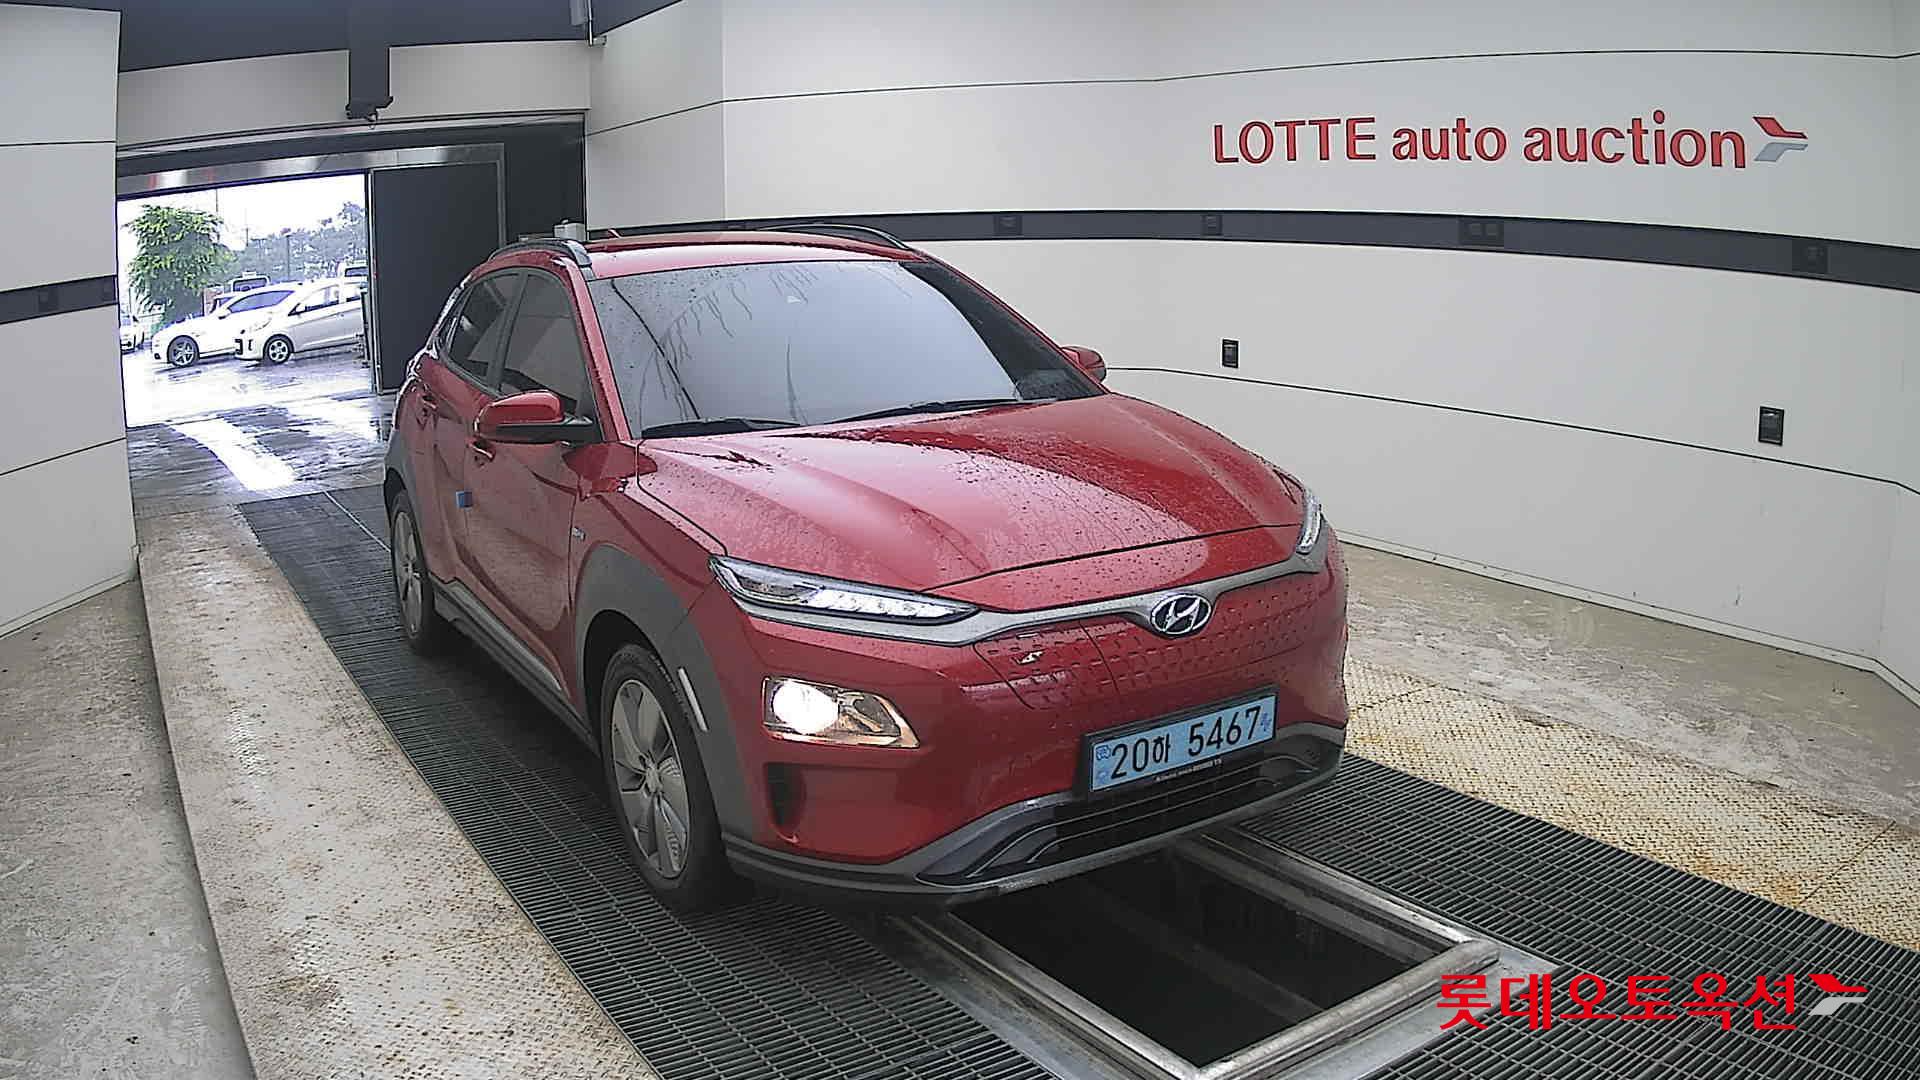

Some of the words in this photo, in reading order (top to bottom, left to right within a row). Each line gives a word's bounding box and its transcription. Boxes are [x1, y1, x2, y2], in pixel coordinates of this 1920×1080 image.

[1213, 116, 1376, 164] LOTTE
[1392, 117, 1508, 162] auto
[1523, 109, 1747, 169] auction
[1110, 732, 1172, 780] 20하
[1187, 705, 1262, 758] 5467
